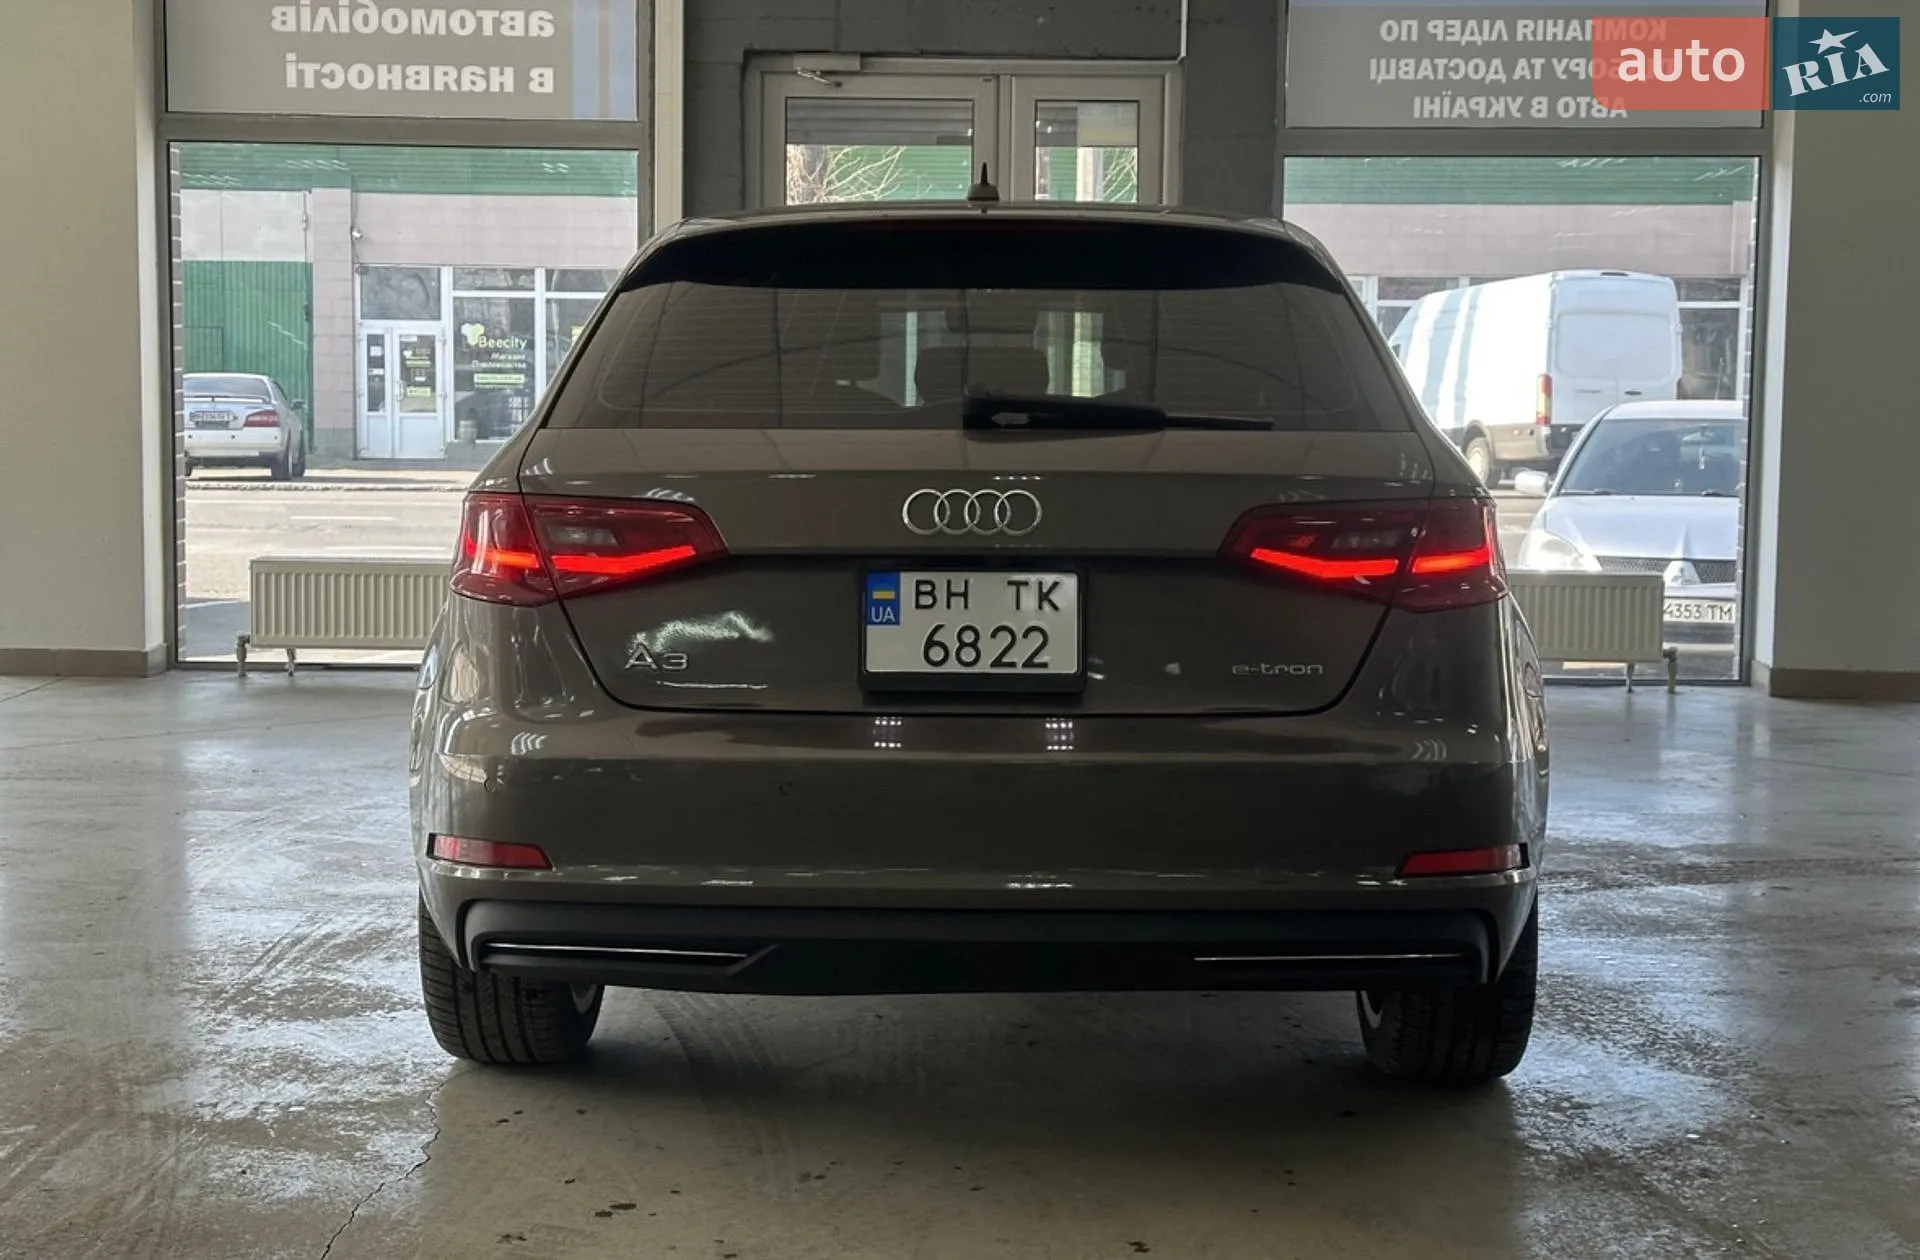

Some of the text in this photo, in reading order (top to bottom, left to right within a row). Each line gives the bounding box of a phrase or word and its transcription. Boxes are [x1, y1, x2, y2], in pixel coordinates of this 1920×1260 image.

[478, 335, 528, 351] Beecity
[914, 579, 1061, 611] BH TK
[871, 606, 896, 623] UA
[1707, 604, 1733, 621] TM
[922, 623, 1050, 669] 6822
[624, 642, 689, 670] A3
[1232, 663, 1324, 675] e-tron
